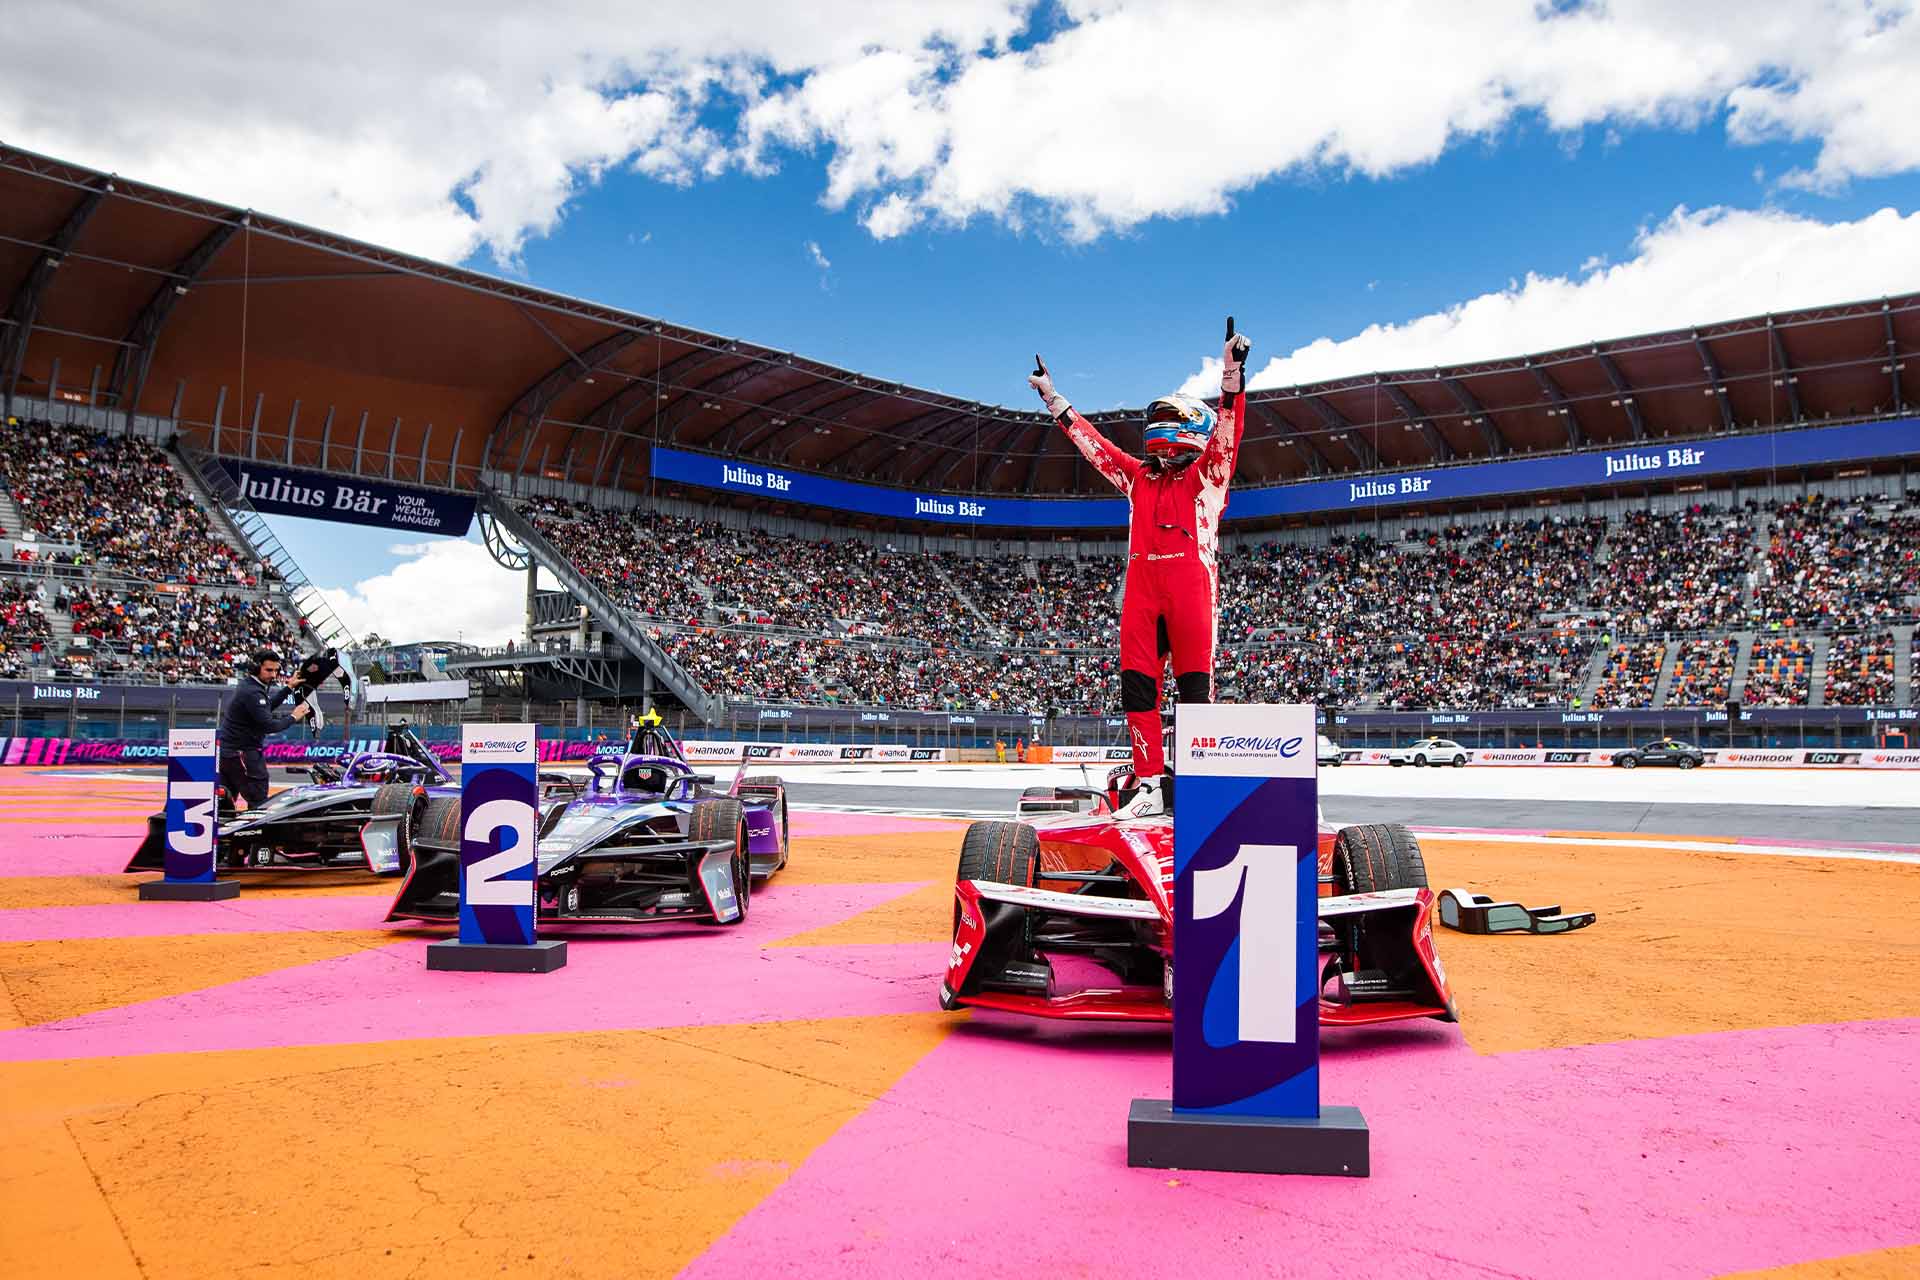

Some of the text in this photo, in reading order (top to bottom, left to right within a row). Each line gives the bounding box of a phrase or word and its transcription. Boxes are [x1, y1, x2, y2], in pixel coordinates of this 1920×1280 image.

[1605, 449, 1704, 476] Julius Bär
[723, 465, 791, 491] Julius Bär
[239, 472, 387, 514] Julius Bär
[1350, 477, 1431, 501] Julius Bär
[398, 495, 425, 507] YOUR
[915, 498, 985, 517] Julius Bär
[395, 505, 435, 518] WEALTH
[392, 514, 441, 527] MANAGER
[33, 686, 100, 699] Julius Bär
[1432, 714, 1469, 724] Julius Bär
[1562, 713, 1604, 722] Julius Bär
[1706, 712, 1727, 721] Juliu
[1899, 708, 1918, 719] Bär
[484, 741, 516, 749] FORMULA
[1190, 737, 1216, 748] ABB
[1218, 736, 1279, 750] FORMULA
[73, 743, 168, 758] ATTACK MODE
[262, 743, 344, 758] ATTACK MODE
[596, 745, 624, 755] MODE
[1191, 750, 1204, 758] FIA
[1887, 755, 1920, 763] HANK
[168, 782, 214, 855] 3
[465, 800, 534, 905] 2
[550, 865, 575, 877] PORSCHE
[1193, 844, 1297, 1043] 1
